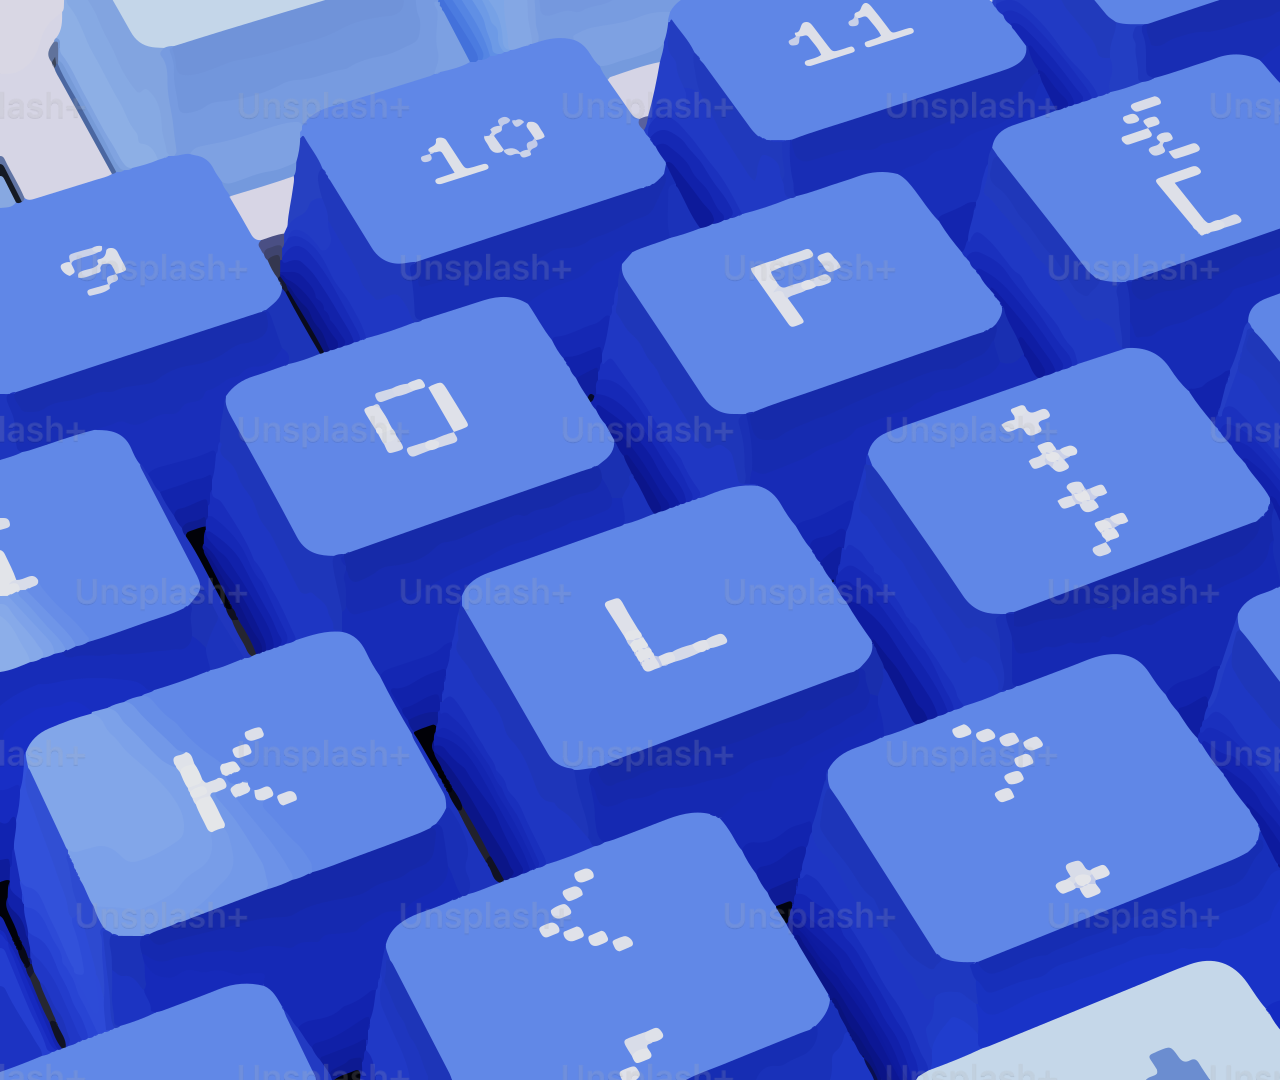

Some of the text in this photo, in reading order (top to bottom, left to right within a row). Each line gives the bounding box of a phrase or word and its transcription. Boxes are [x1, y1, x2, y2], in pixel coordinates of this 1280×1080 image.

[788, 2, 915, 67] 11
[420, 116, 546, 185] 10
[750, 248, 841, 328] P
[604, 598, 728, 672] L
[173, 727, 298, 833] K
